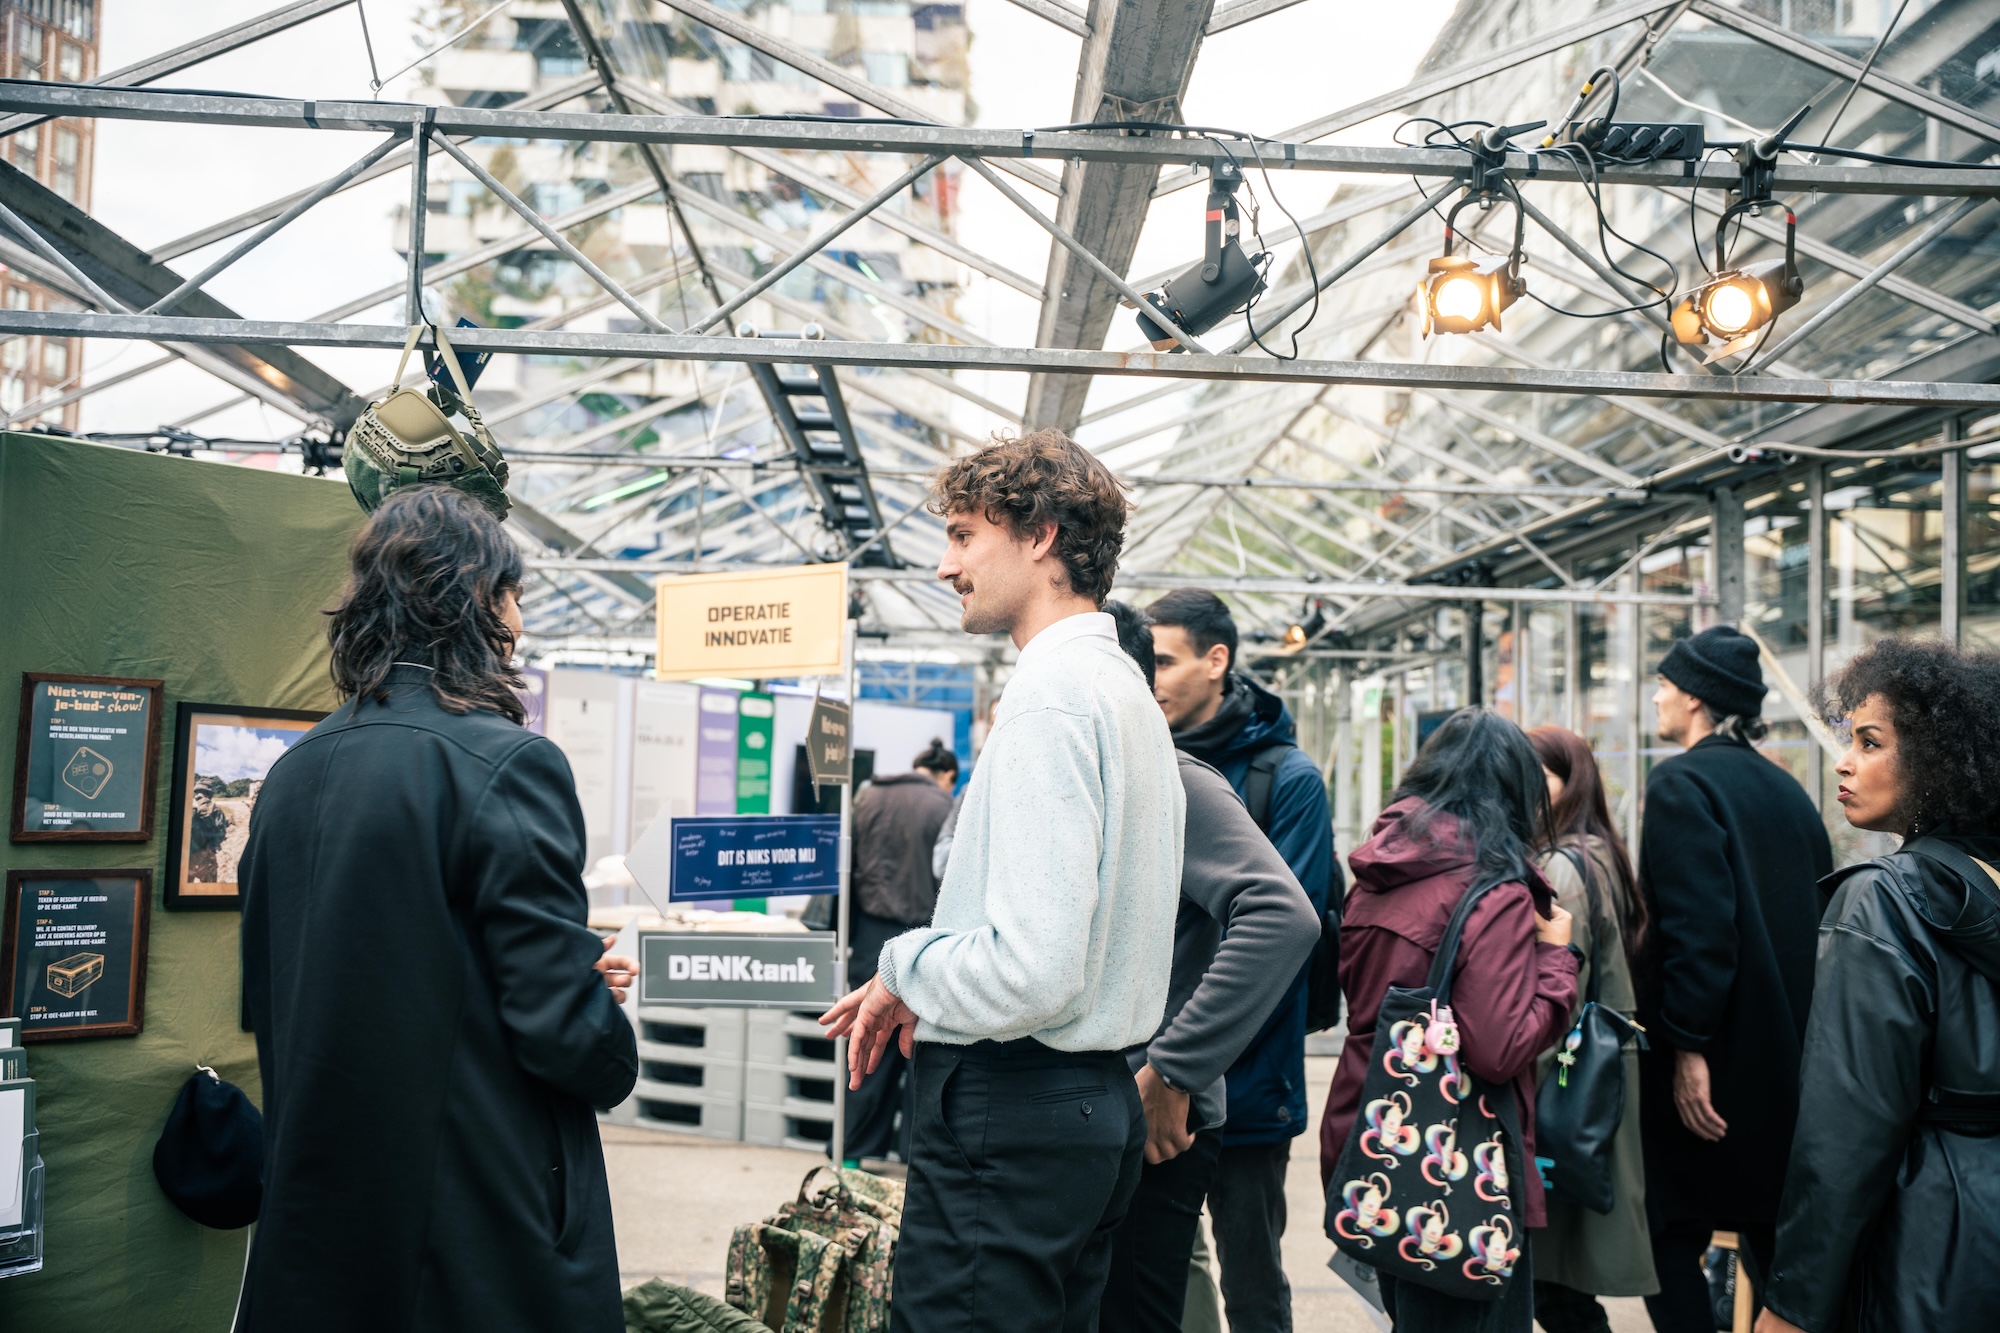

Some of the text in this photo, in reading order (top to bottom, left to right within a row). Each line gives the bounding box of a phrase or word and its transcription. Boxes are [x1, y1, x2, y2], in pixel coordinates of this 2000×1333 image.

[708, 602, 790, 622] OPERATIE
[705, 627, 792, 647] INNOVATIE
[47, 685, 141, 700] Niet-ver-van-
[54, 697, 145, 713] je-bed- show!
[718, 847, 816, 866] DIT IS NIKS VOOR MIJ
[668, 954, 816, 983] DENKtank
[48, 1011, 74, 1019] IDEE-KAART
